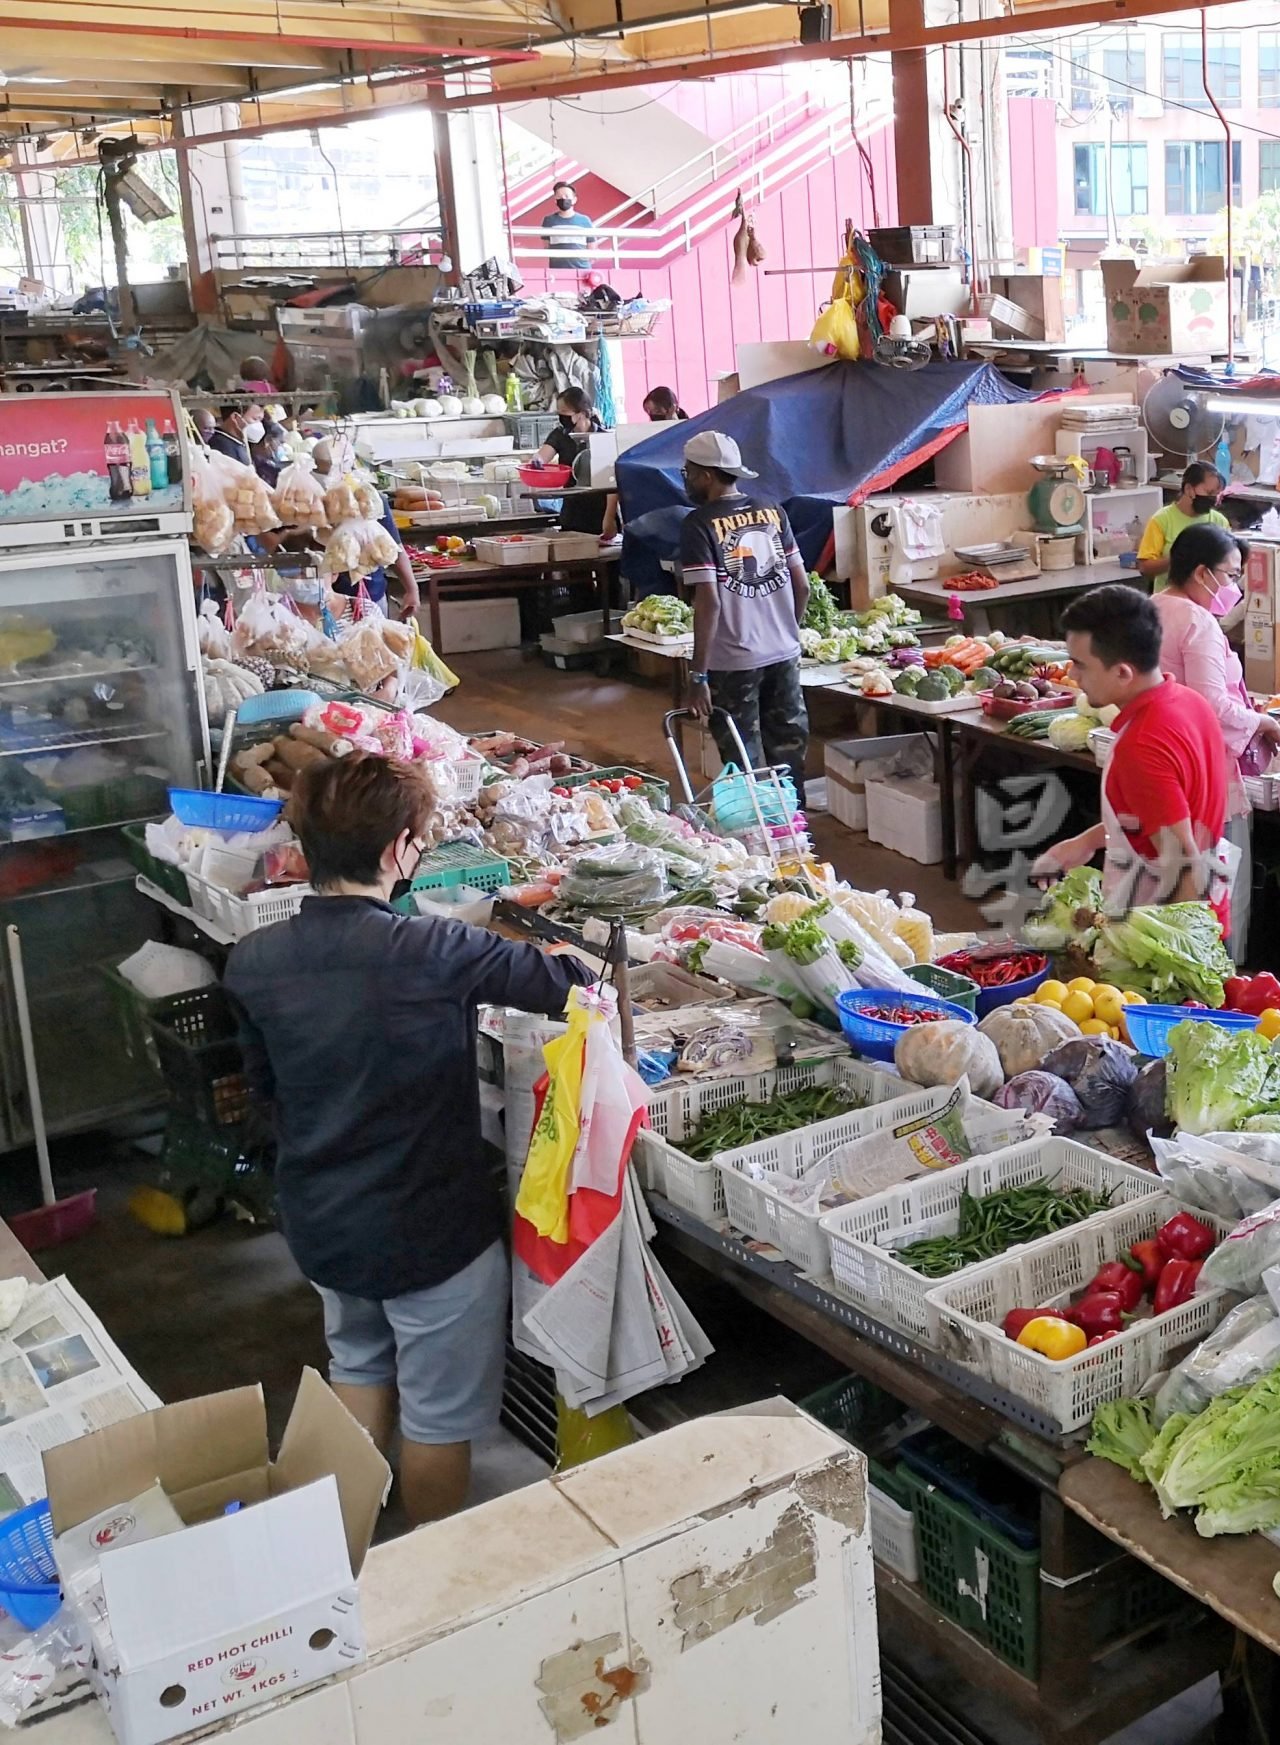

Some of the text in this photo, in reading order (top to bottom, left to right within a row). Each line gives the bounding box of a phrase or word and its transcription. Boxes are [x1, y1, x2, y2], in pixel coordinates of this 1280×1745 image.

[712, 509, 782, 544] INDIAN
[188, 1657, 214, 1672] RED
[218, 1643, 247, 1661] HOT
[251, 1626, 293, 1648] CHILLI
[192, 1700, 217, 1716] NET
[222, 1689, 245, 1704] WT.
[251, 1673, 286, 1693] 1KGS
